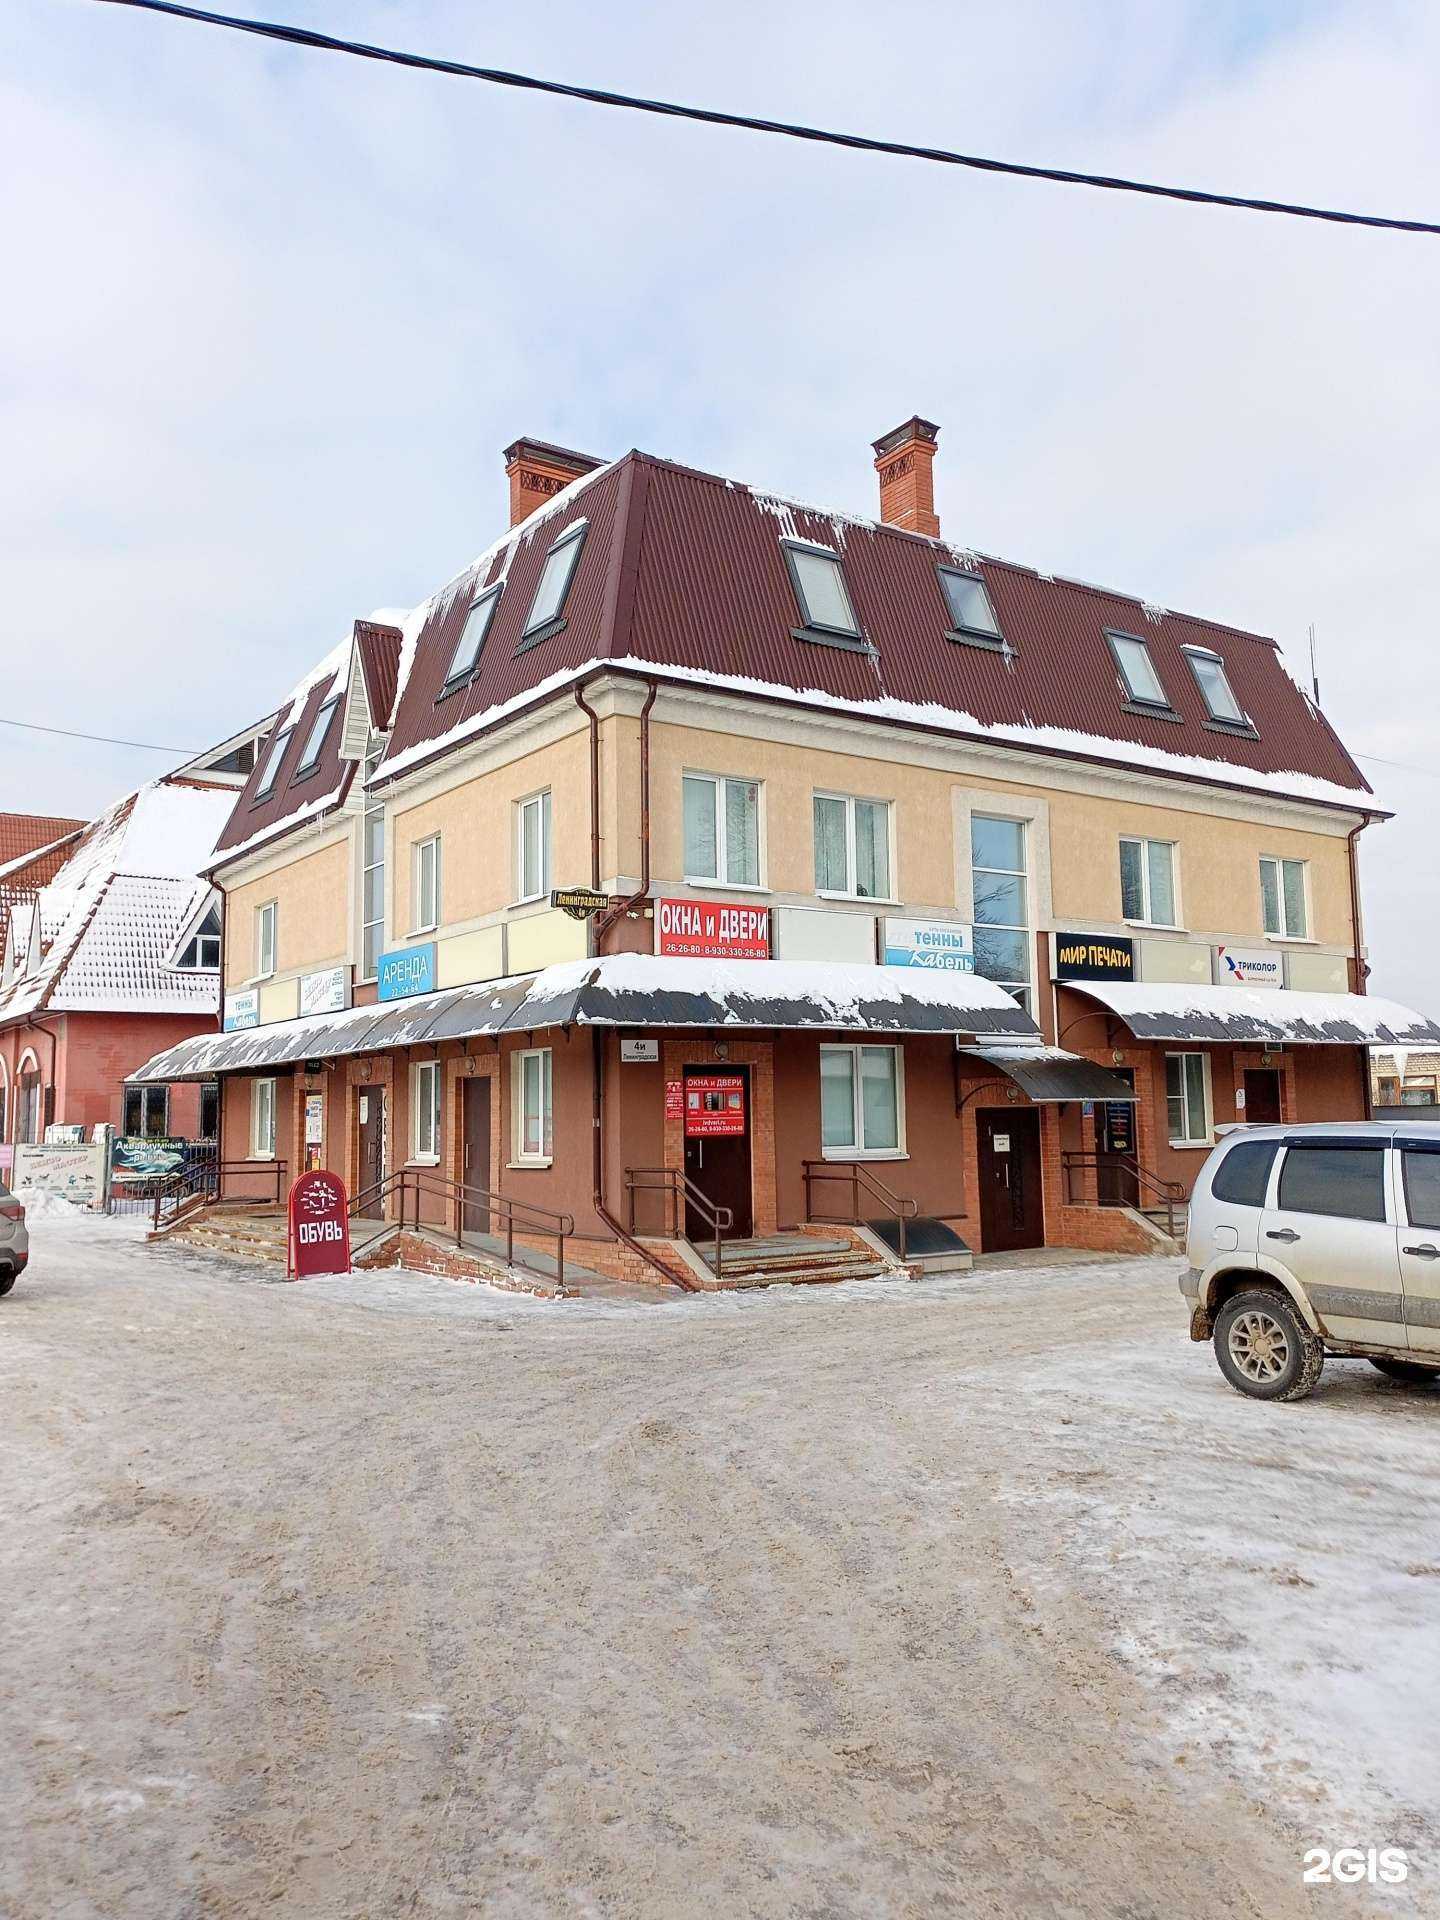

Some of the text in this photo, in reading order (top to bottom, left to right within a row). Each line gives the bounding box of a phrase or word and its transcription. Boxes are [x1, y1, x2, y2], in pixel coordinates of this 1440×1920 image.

[661, 904, 767, 944] ОКНА и ДВЕРИ
[666, 943, 766, 958] 26-26-80 8-930-330-26-80
[909, 950, 973, 971] Кабель
[1060, 945, 1131, 968] МИР ПЕЧАТИ
[383, 955, 428, 985] АРЕНДА
[1237, 961, 1277, 973] ТРИКОЛОР
[687, 1079, 709, 1087] ОКНА
[717, 1079, 742, 1088] ДВЕРИ
[116, 1140, 183, 1151] Аквариумные
[299, 1220, 343, 1244] ОБУВЬ
